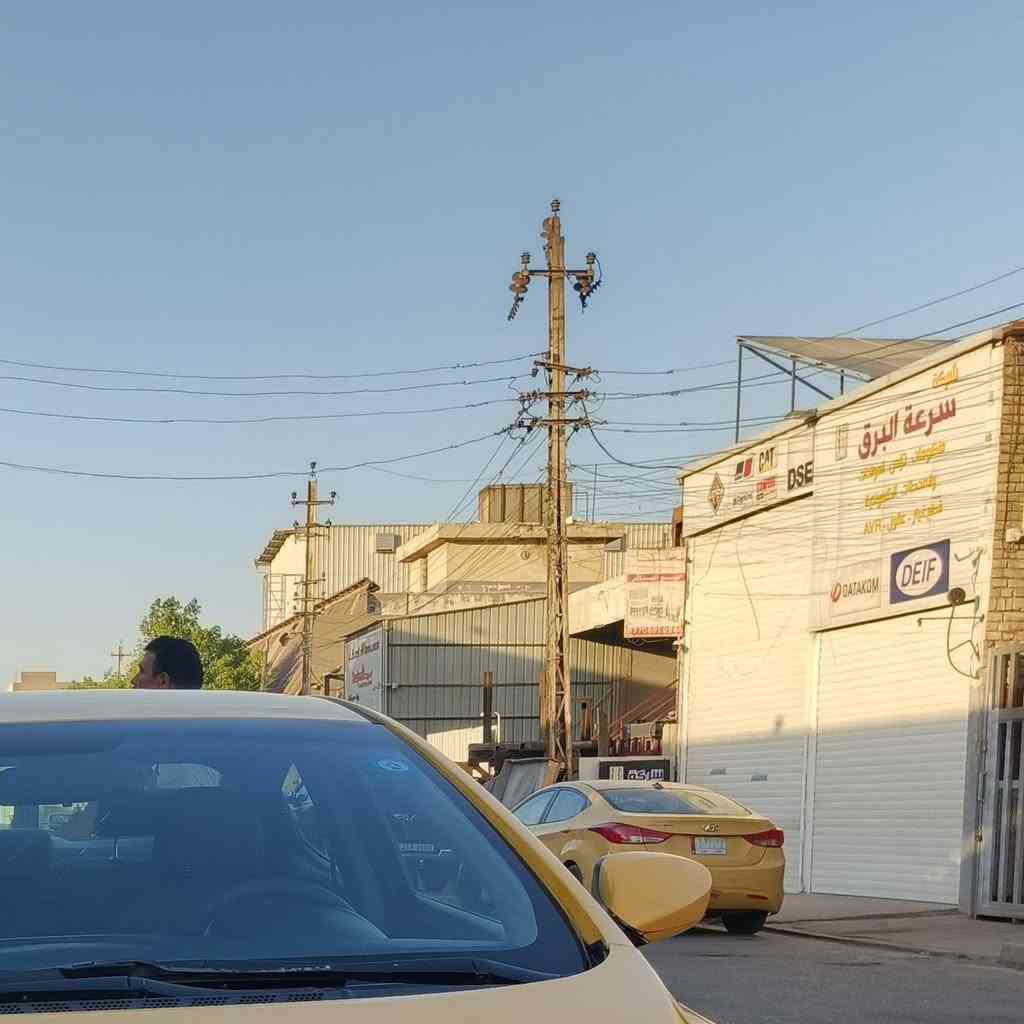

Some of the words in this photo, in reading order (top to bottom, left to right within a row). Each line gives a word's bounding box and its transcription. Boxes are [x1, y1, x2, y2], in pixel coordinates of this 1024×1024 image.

[902, 398, 957, 437] سرعة
[857, 409, 899, 460] البرق
[787, 461, 814, 492] DSE
[842, 577, 880, 598] DATAKOM
[901, 558, 937, 588] DEIF
